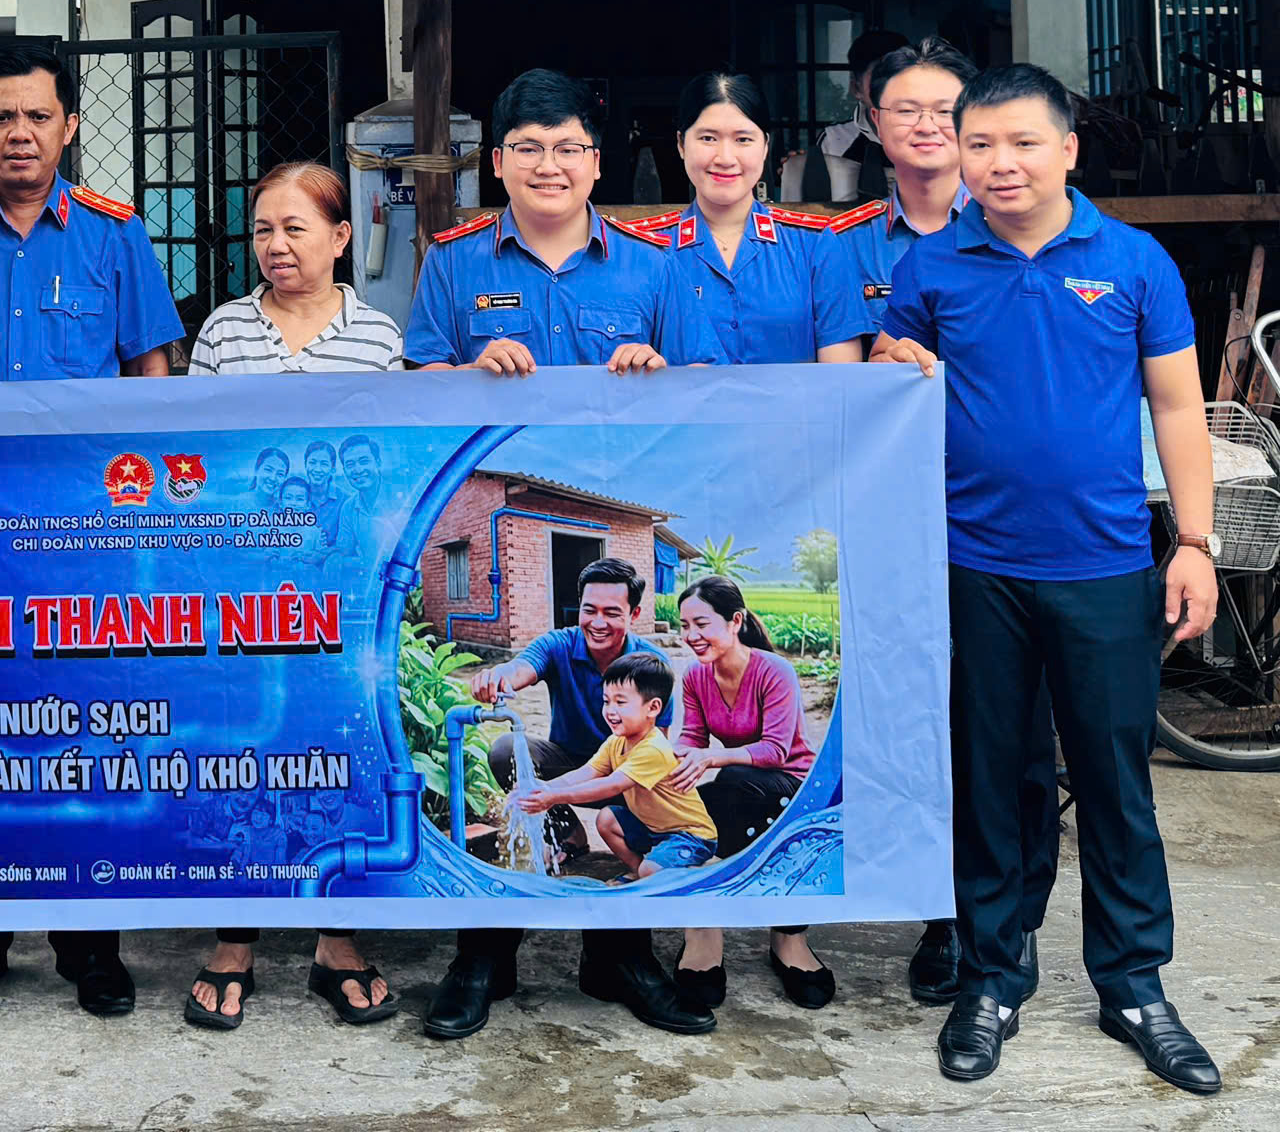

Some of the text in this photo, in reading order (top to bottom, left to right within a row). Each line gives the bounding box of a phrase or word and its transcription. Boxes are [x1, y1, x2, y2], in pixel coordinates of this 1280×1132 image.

[43, 517, 78, 529] TNCS
[83, 511, 104, 528] HỒ
[109, 513, 133, 527] CHÍ
[138, 515, 174, 527] MINH
[179, 515, 225, 529] VKSND
[228, 514, 246, 527] TP
[249, 511, 270, 527] ĐÀ
[273, 508, 316, 526] NẴNG
[13, 539, 37, 550] CHI
[42, 535, 83, 549] ĐOÀN
[88, 537, 134, 548] VKSND
[140, 536, 167, 547] KHU
[171, 534, 202, 550] VỰC
[207, 535, 222, 548] 10
[234, 532, 256, 547] ĐÀ
[258, 529, 302, 546] NẴNG
[25, 593, 205, 649] THANH
[216, 580, 341, 650] NIÊN
[0, 696, 79, 735] NƯỚC
[90, 702, 167, 741] SẠCH
[41, 748, 93, 790] KẾT
[102, 751, 141, 790] VÀ
[150, 751, 188, 796] HỘ
[199, 750, 257, 789] KHÓ
[268, 749, 348, 788] KHĂN
[0, 863, 31, 881] SỐNG
[35, 868, 66, 881] XANH
[120, 864, 152, 879] ĐOÀN
[156, 862, 176, 879] KẾT
[189, 866, 216, 879] CHIA
[219, 862, 234, 879] SẺ
[246, 863, 268, 879] YÊU
[271, 863, 319, 879] THƯƠNG
